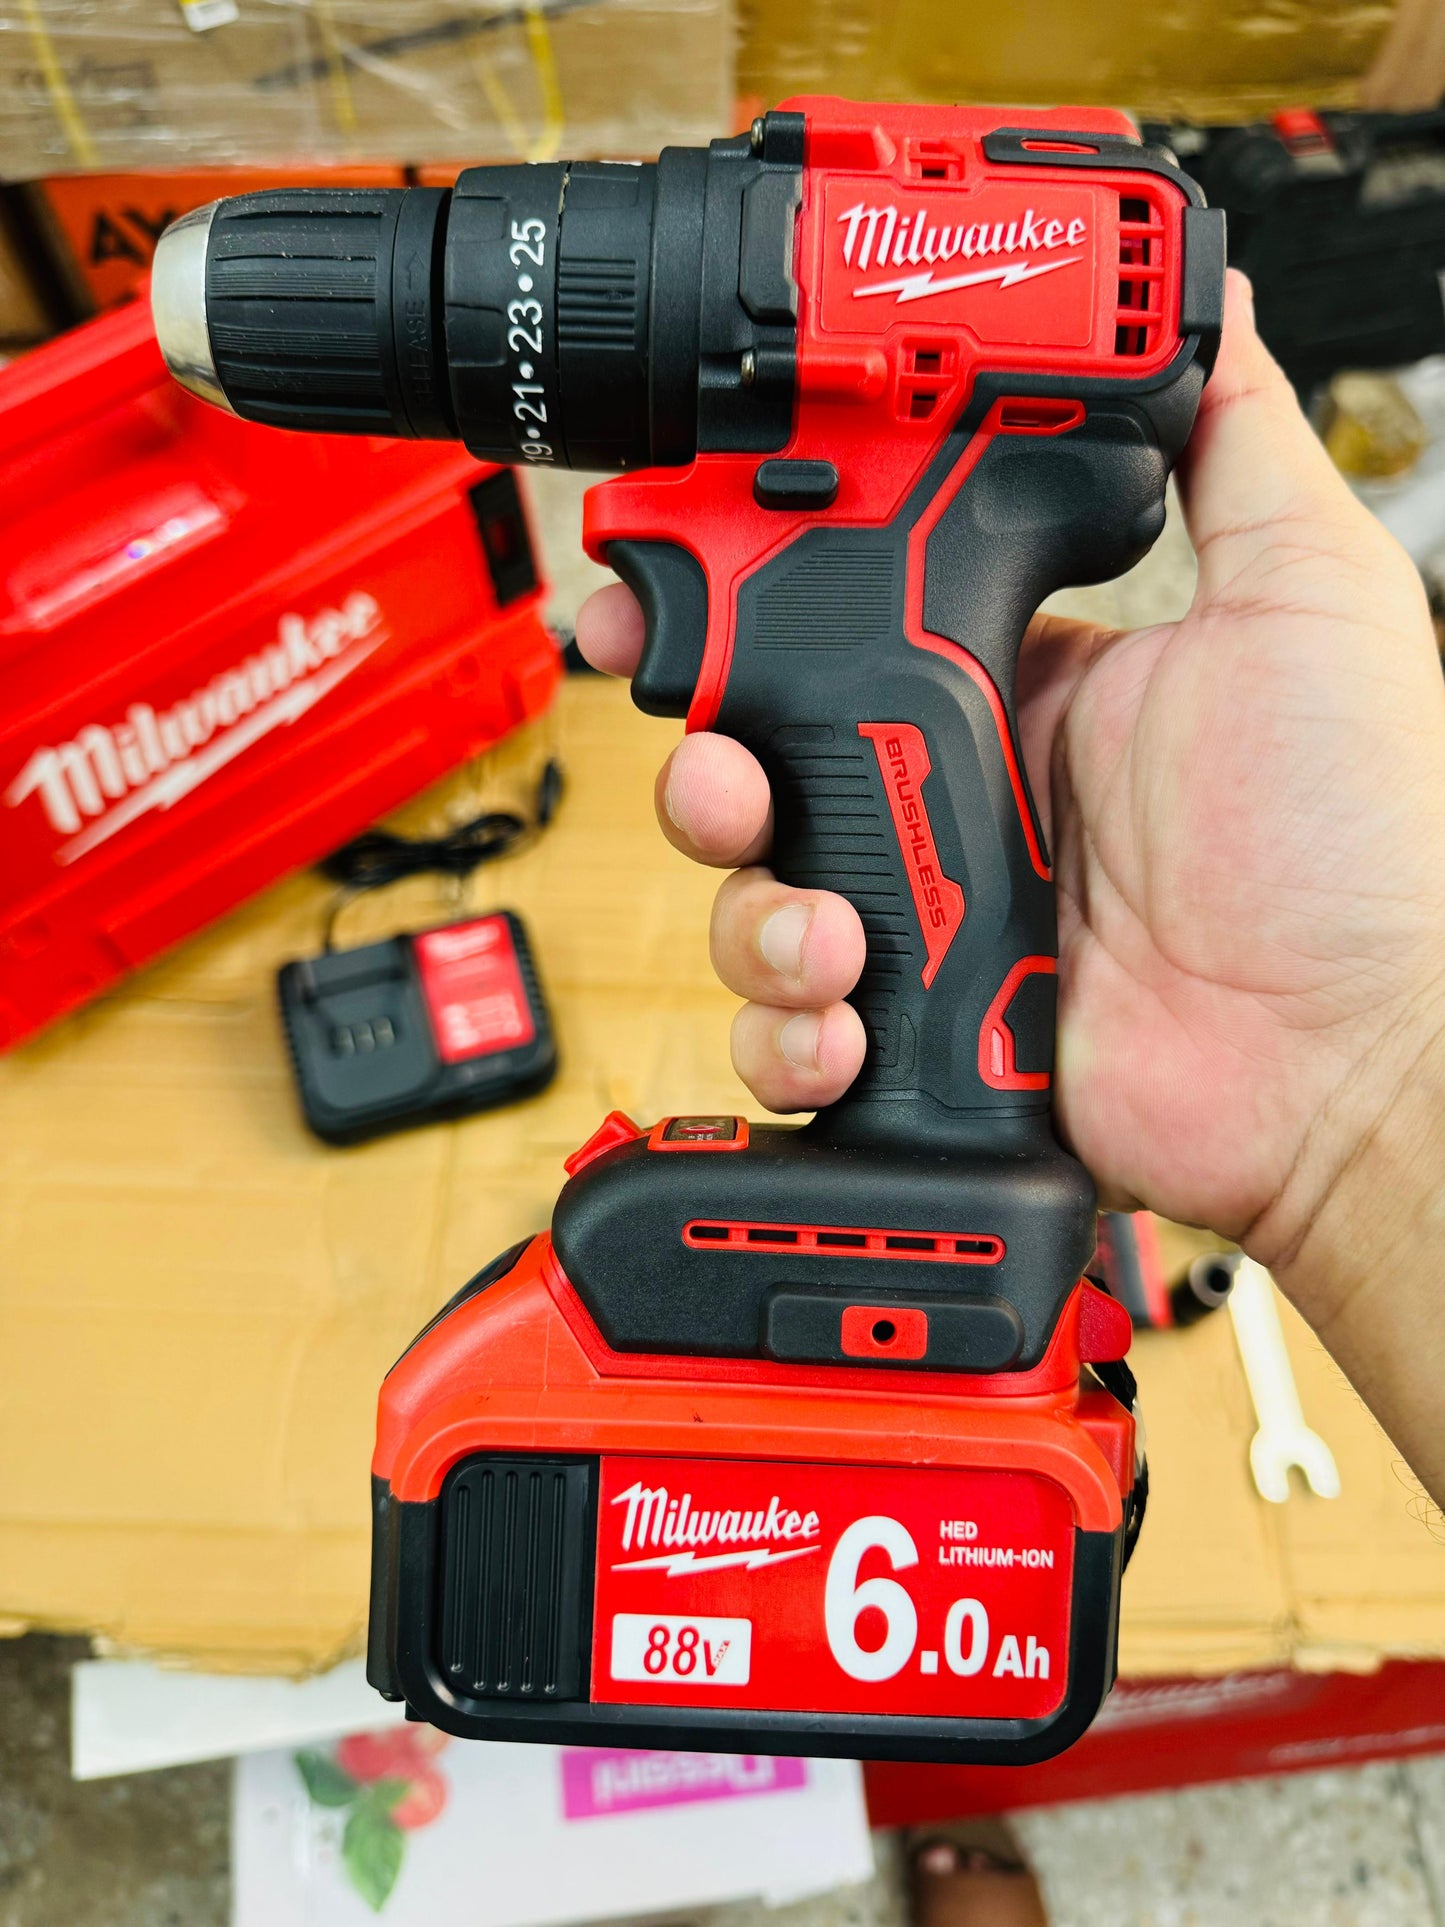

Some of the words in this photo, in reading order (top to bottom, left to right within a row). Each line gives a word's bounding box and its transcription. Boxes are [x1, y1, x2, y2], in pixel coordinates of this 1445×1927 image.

[509, 217, 546, 267] 25
[837, 202, 1087, 274] Milwaukee
[507, 298, 543, 355] 23
[512, 383, 547, 424] 21
[521, 443, 554, 463] 19
[885, 736, 946, 929] BRUSHLESS
[611, 1481, 820, 1552] Milwaukee
[939, 1520, 978, 1540] HED
[938, 1546, 1054, 1568] LITHIUM-ION
